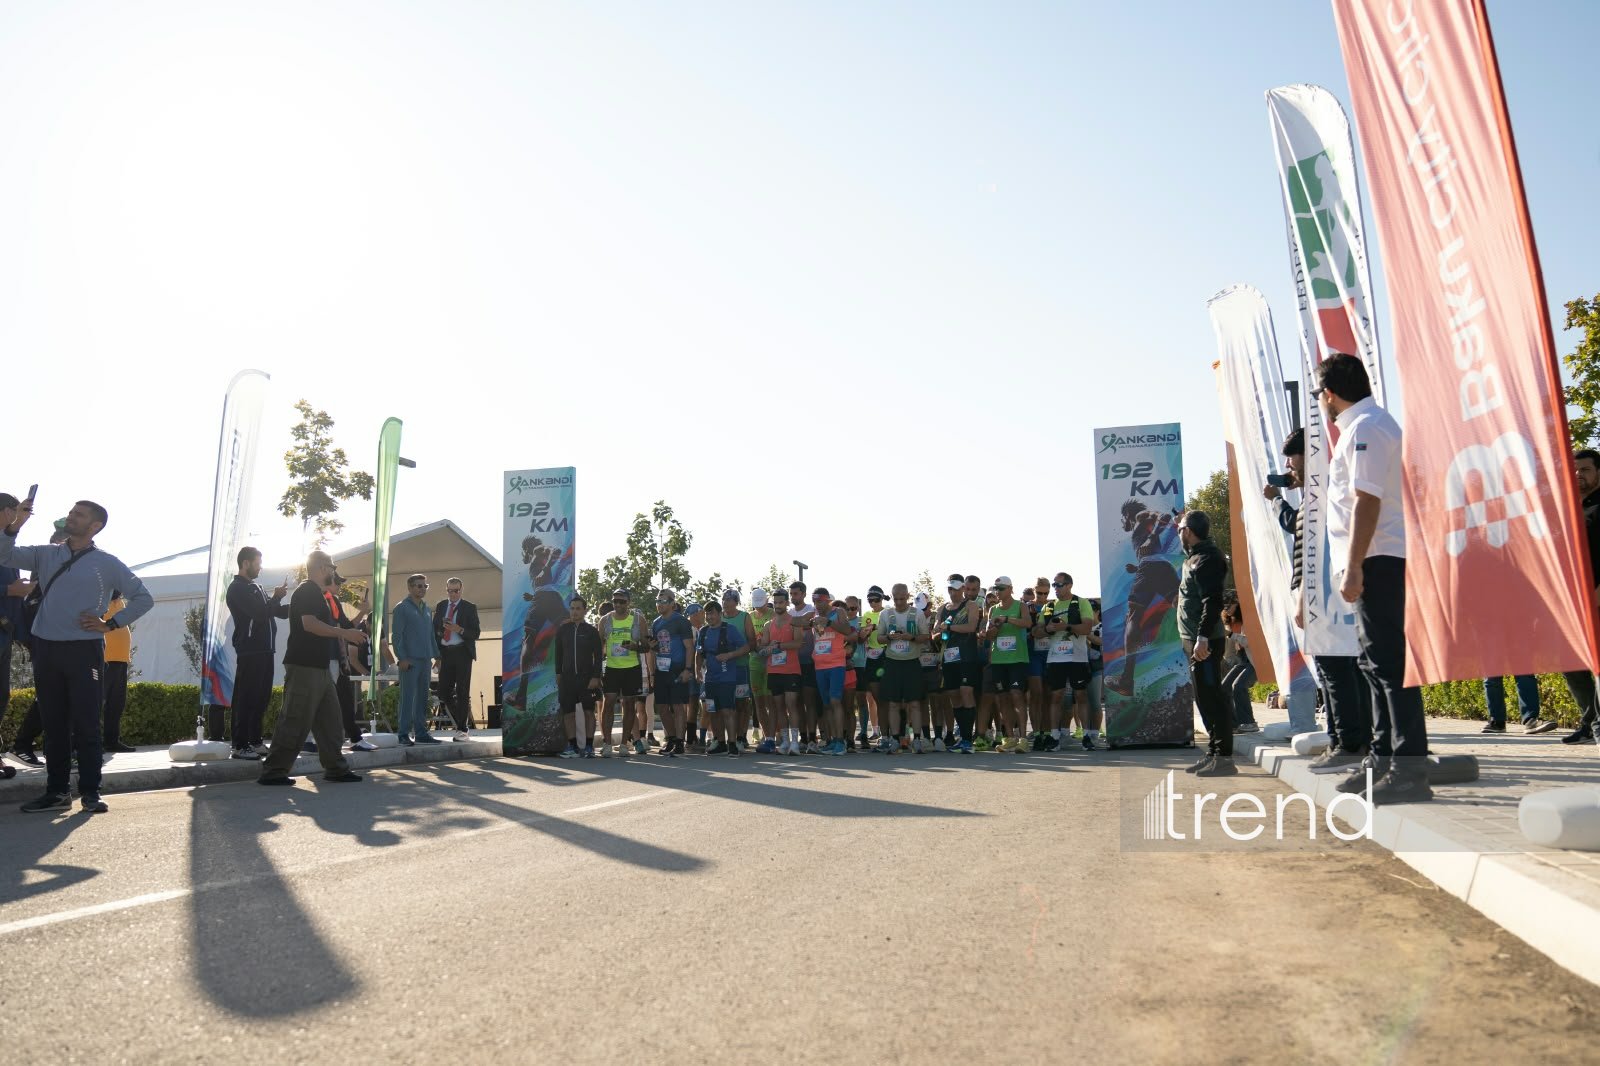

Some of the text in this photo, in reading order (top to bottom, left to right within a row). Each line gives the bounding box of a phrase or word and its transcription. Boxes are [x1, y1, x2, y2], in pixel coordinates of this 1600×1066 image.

[1101, 461, 1154, 480] 192
[1130, 478, 1179, 496] KM
[508, 501, 550, 518] 192
[530, 517, 569, 533] KM
